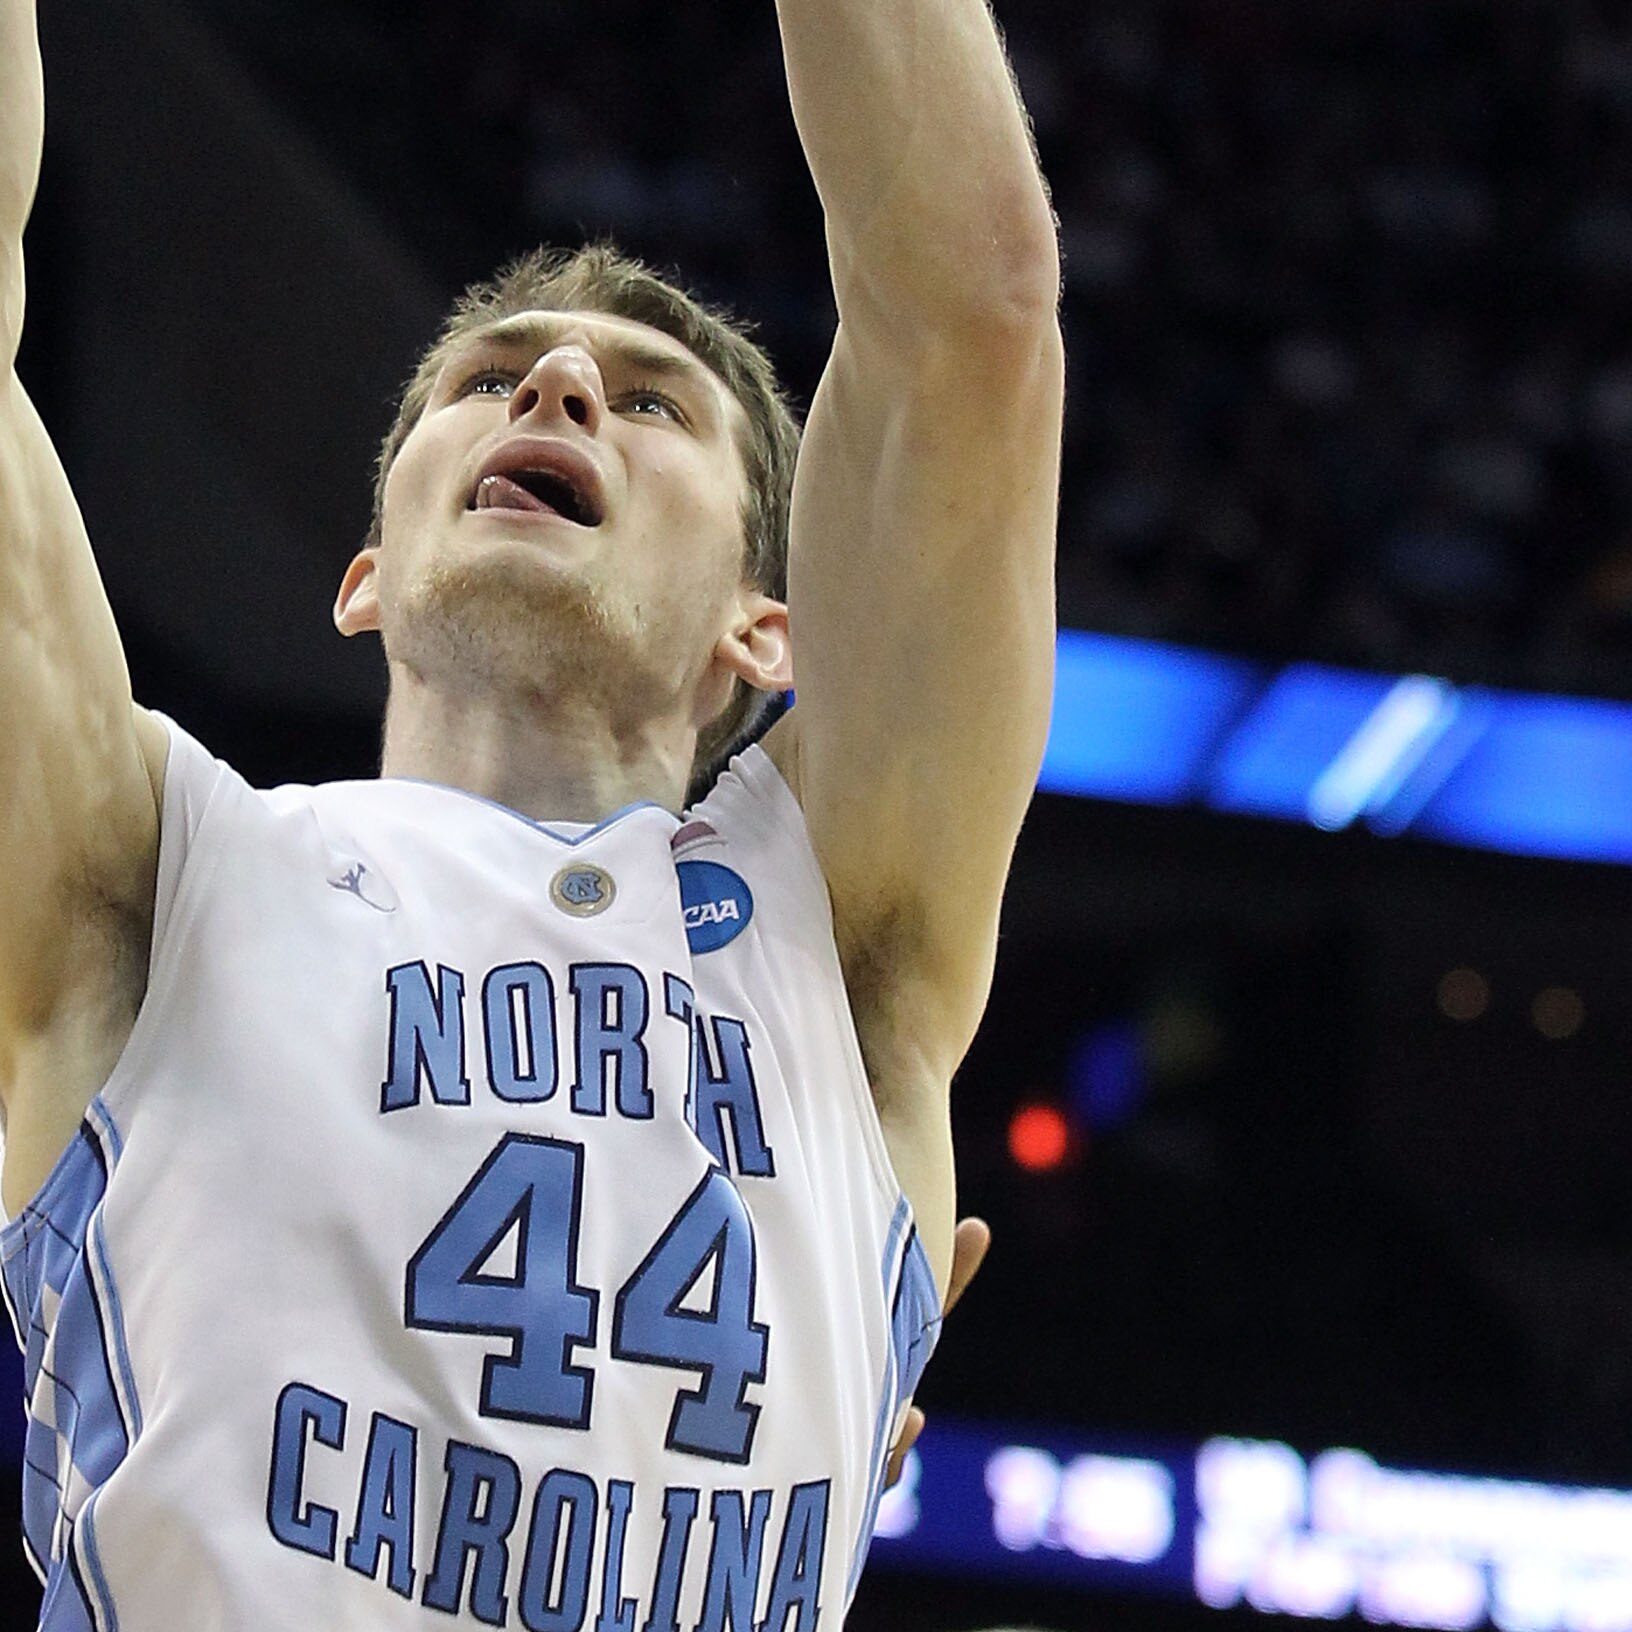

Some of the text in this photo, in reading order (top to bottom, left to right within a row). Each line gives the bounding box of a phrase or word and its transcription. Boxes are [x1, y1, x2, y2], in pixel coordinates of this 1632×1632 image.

[683, 898, 740, 928] CAA
[380, 959, 776, 1178] NORTH
[404, 1132, 771, 1466] 44
